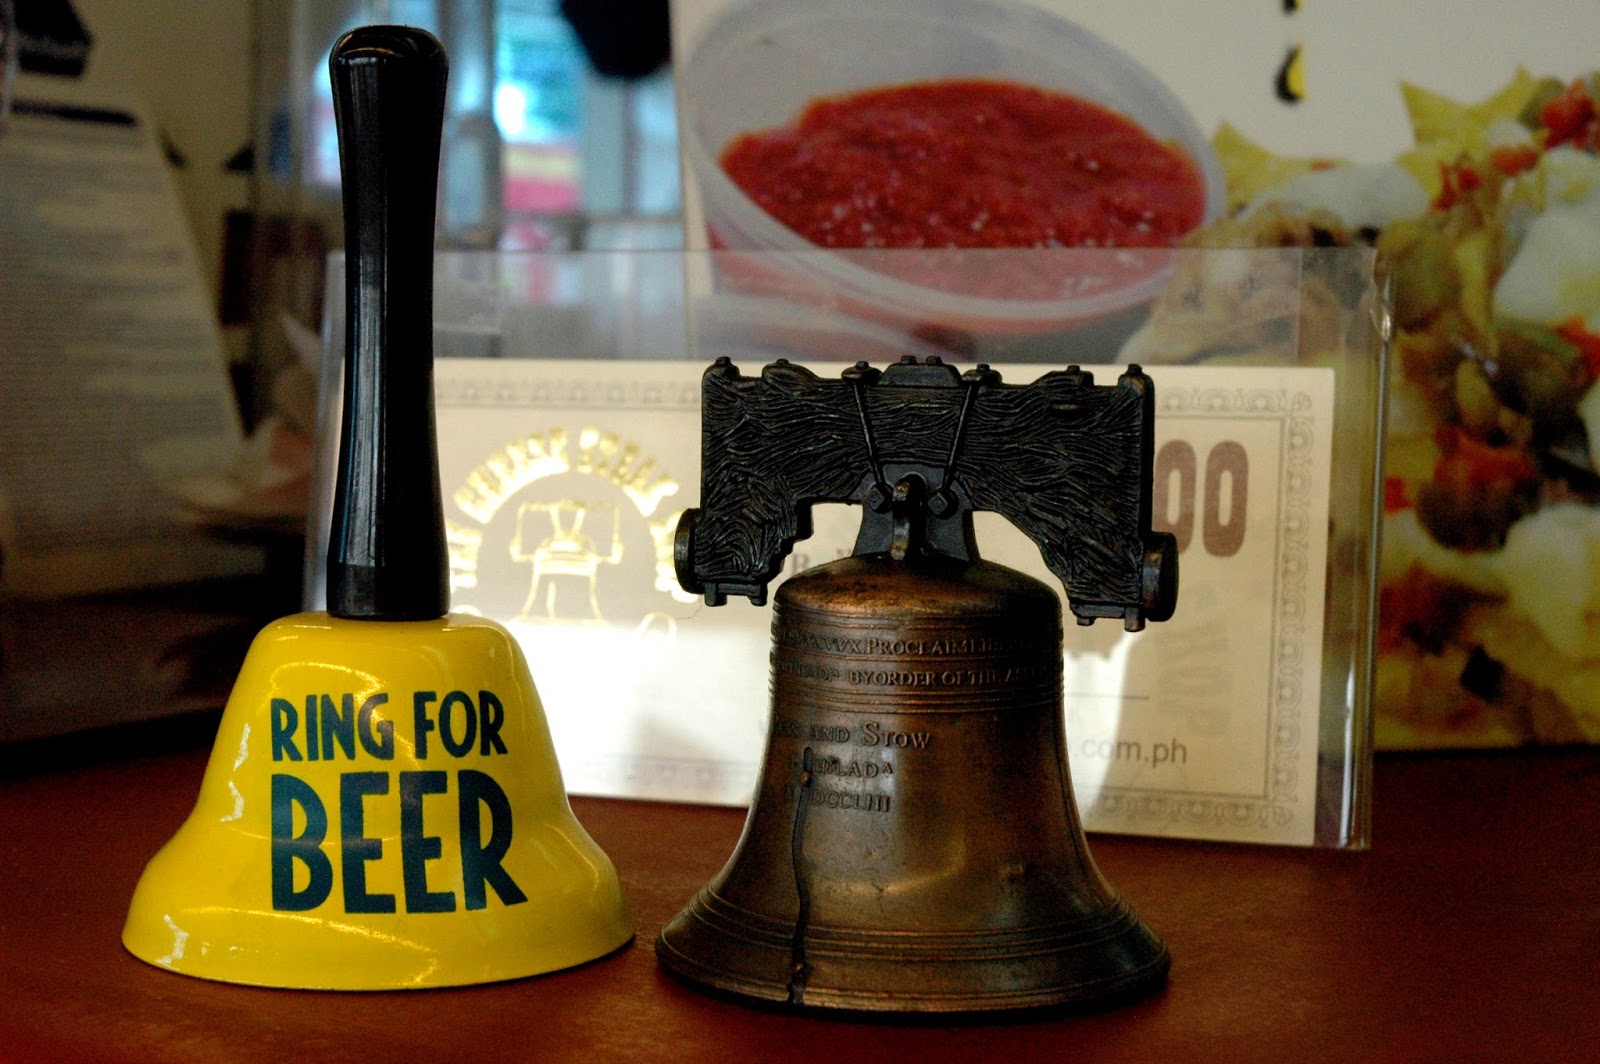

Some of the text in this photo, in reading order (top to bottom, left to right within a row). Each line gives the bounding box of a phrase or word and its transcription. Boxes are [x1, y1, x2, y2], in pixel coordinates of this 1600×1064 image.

[866, 637, 968, 655] PROCLAIM
[271, 690, 508, 761] RING FOR
[271, 769, 528, 914] BEER
